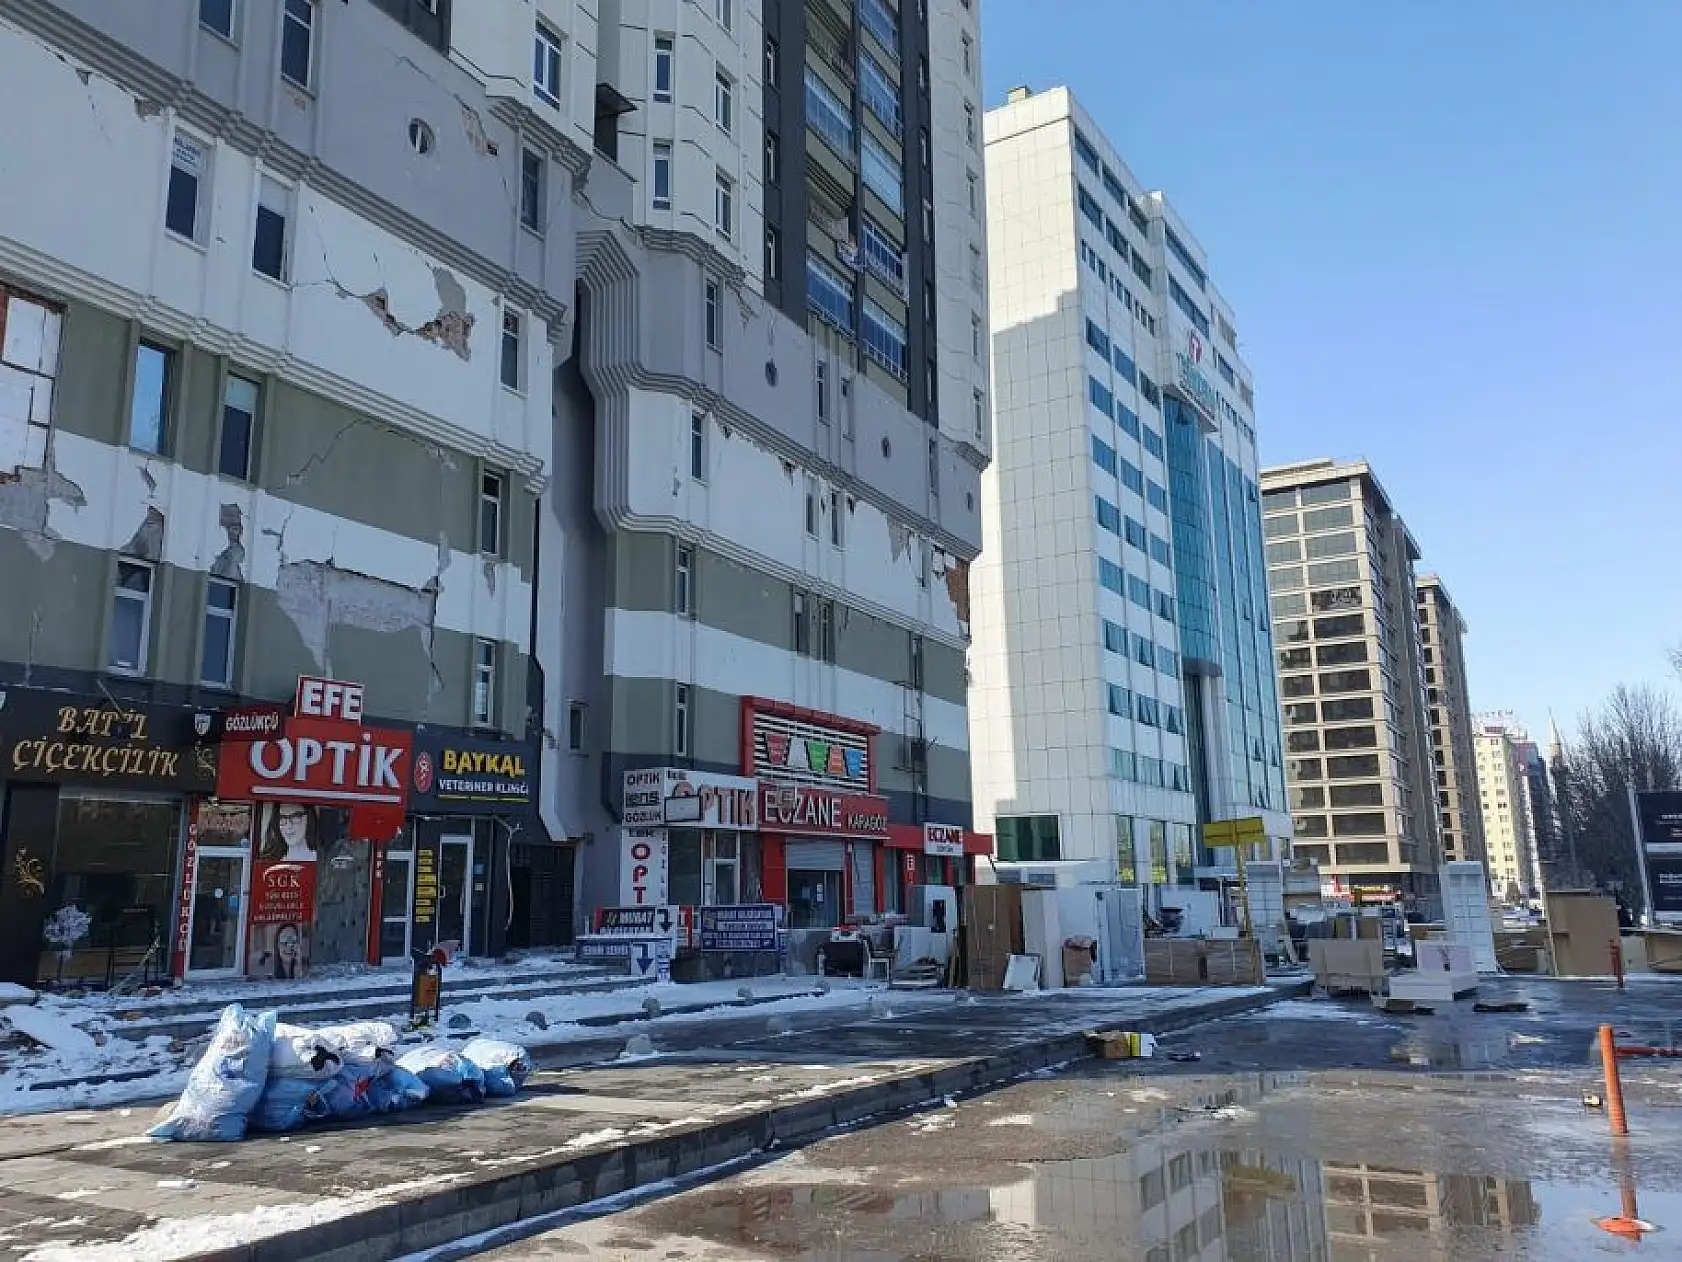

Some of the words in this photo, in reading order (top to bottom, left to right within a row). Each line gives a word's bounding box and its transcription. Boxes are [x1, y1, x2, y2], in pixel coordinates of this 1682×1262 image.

[302, 680, 363, 721] EFE
[251, 732, 404, 788] OPTİK
[443, 750, 525, 777] BAYKAL
